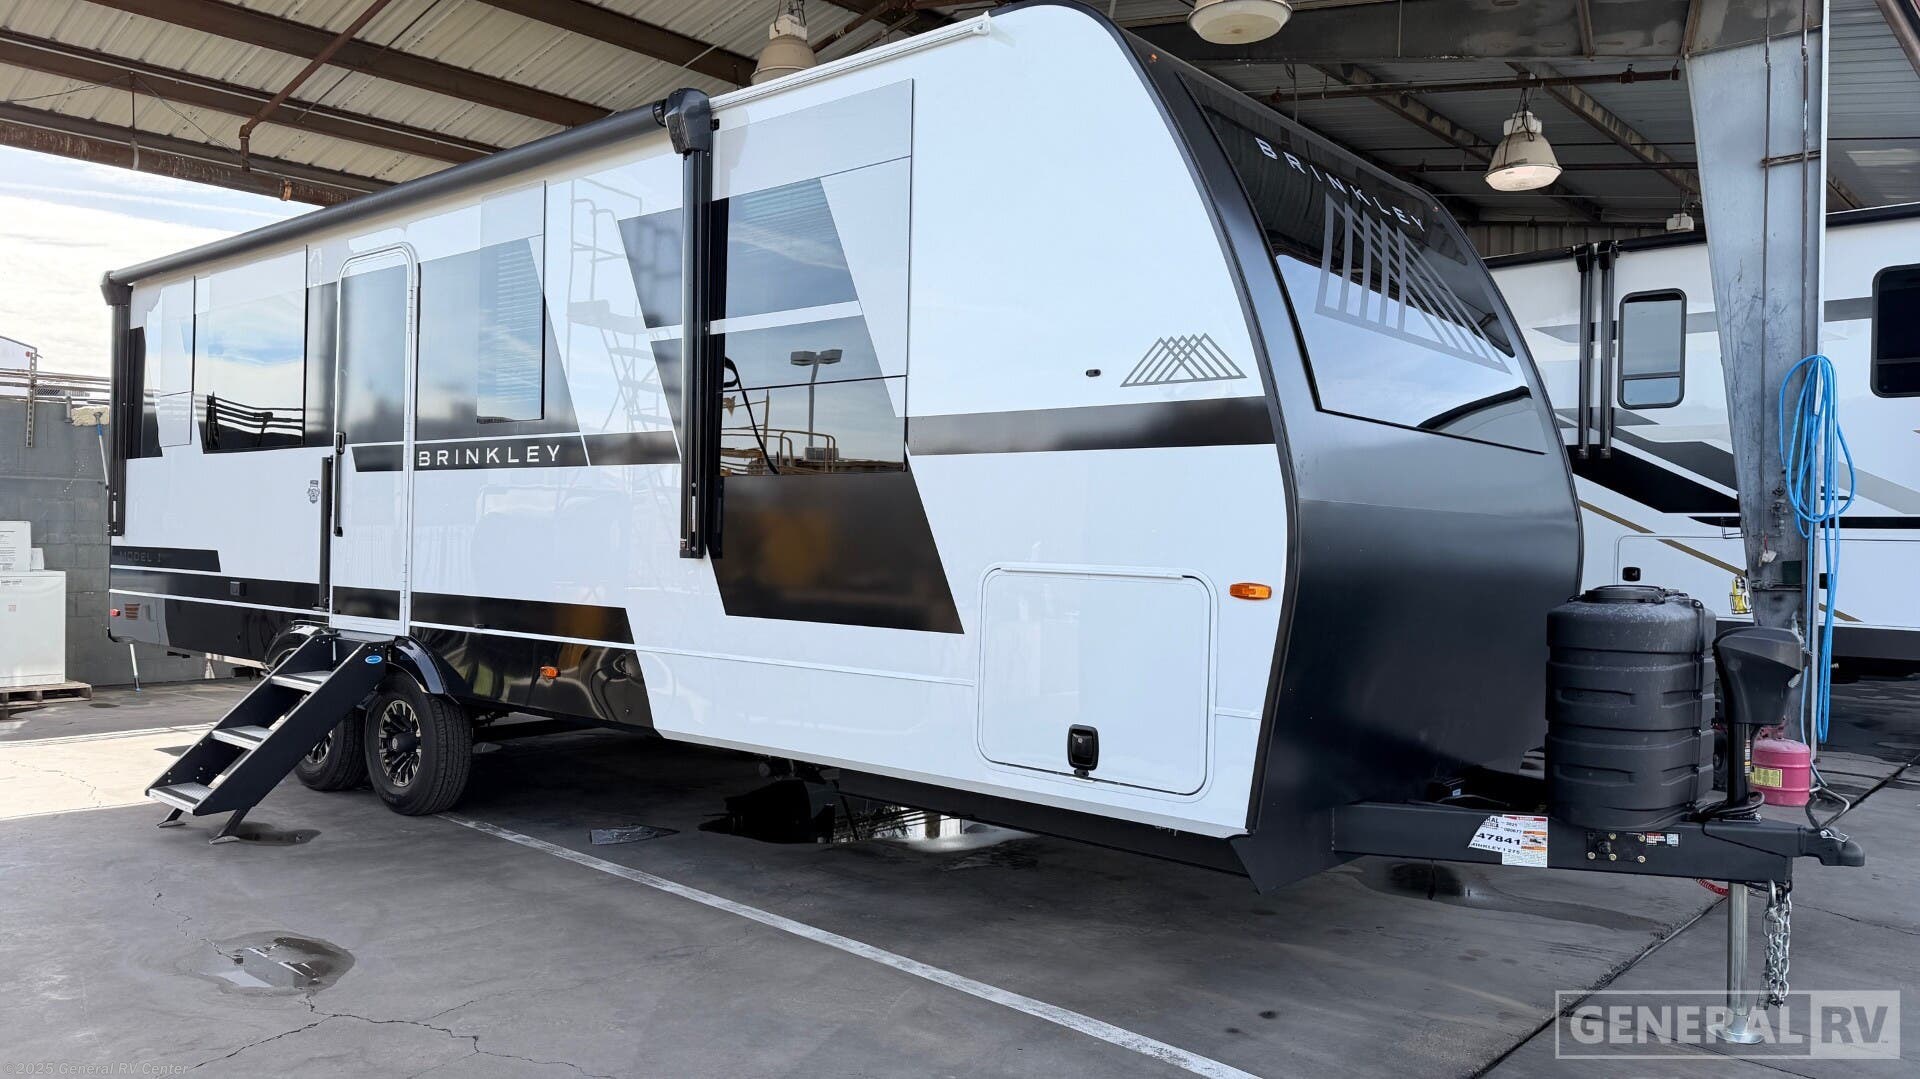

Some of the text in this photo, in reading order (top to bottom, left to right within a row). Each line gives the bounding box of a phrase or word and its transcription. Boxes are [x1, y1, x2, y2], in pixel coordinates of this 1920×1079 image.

[1254, 137, 1426, 233] BRINKLEY
[418, 444, 561, 467] BRINKLEY
[119, 551, 152, 563] MODEL
[1475, 832, 1521, 846] 47841
